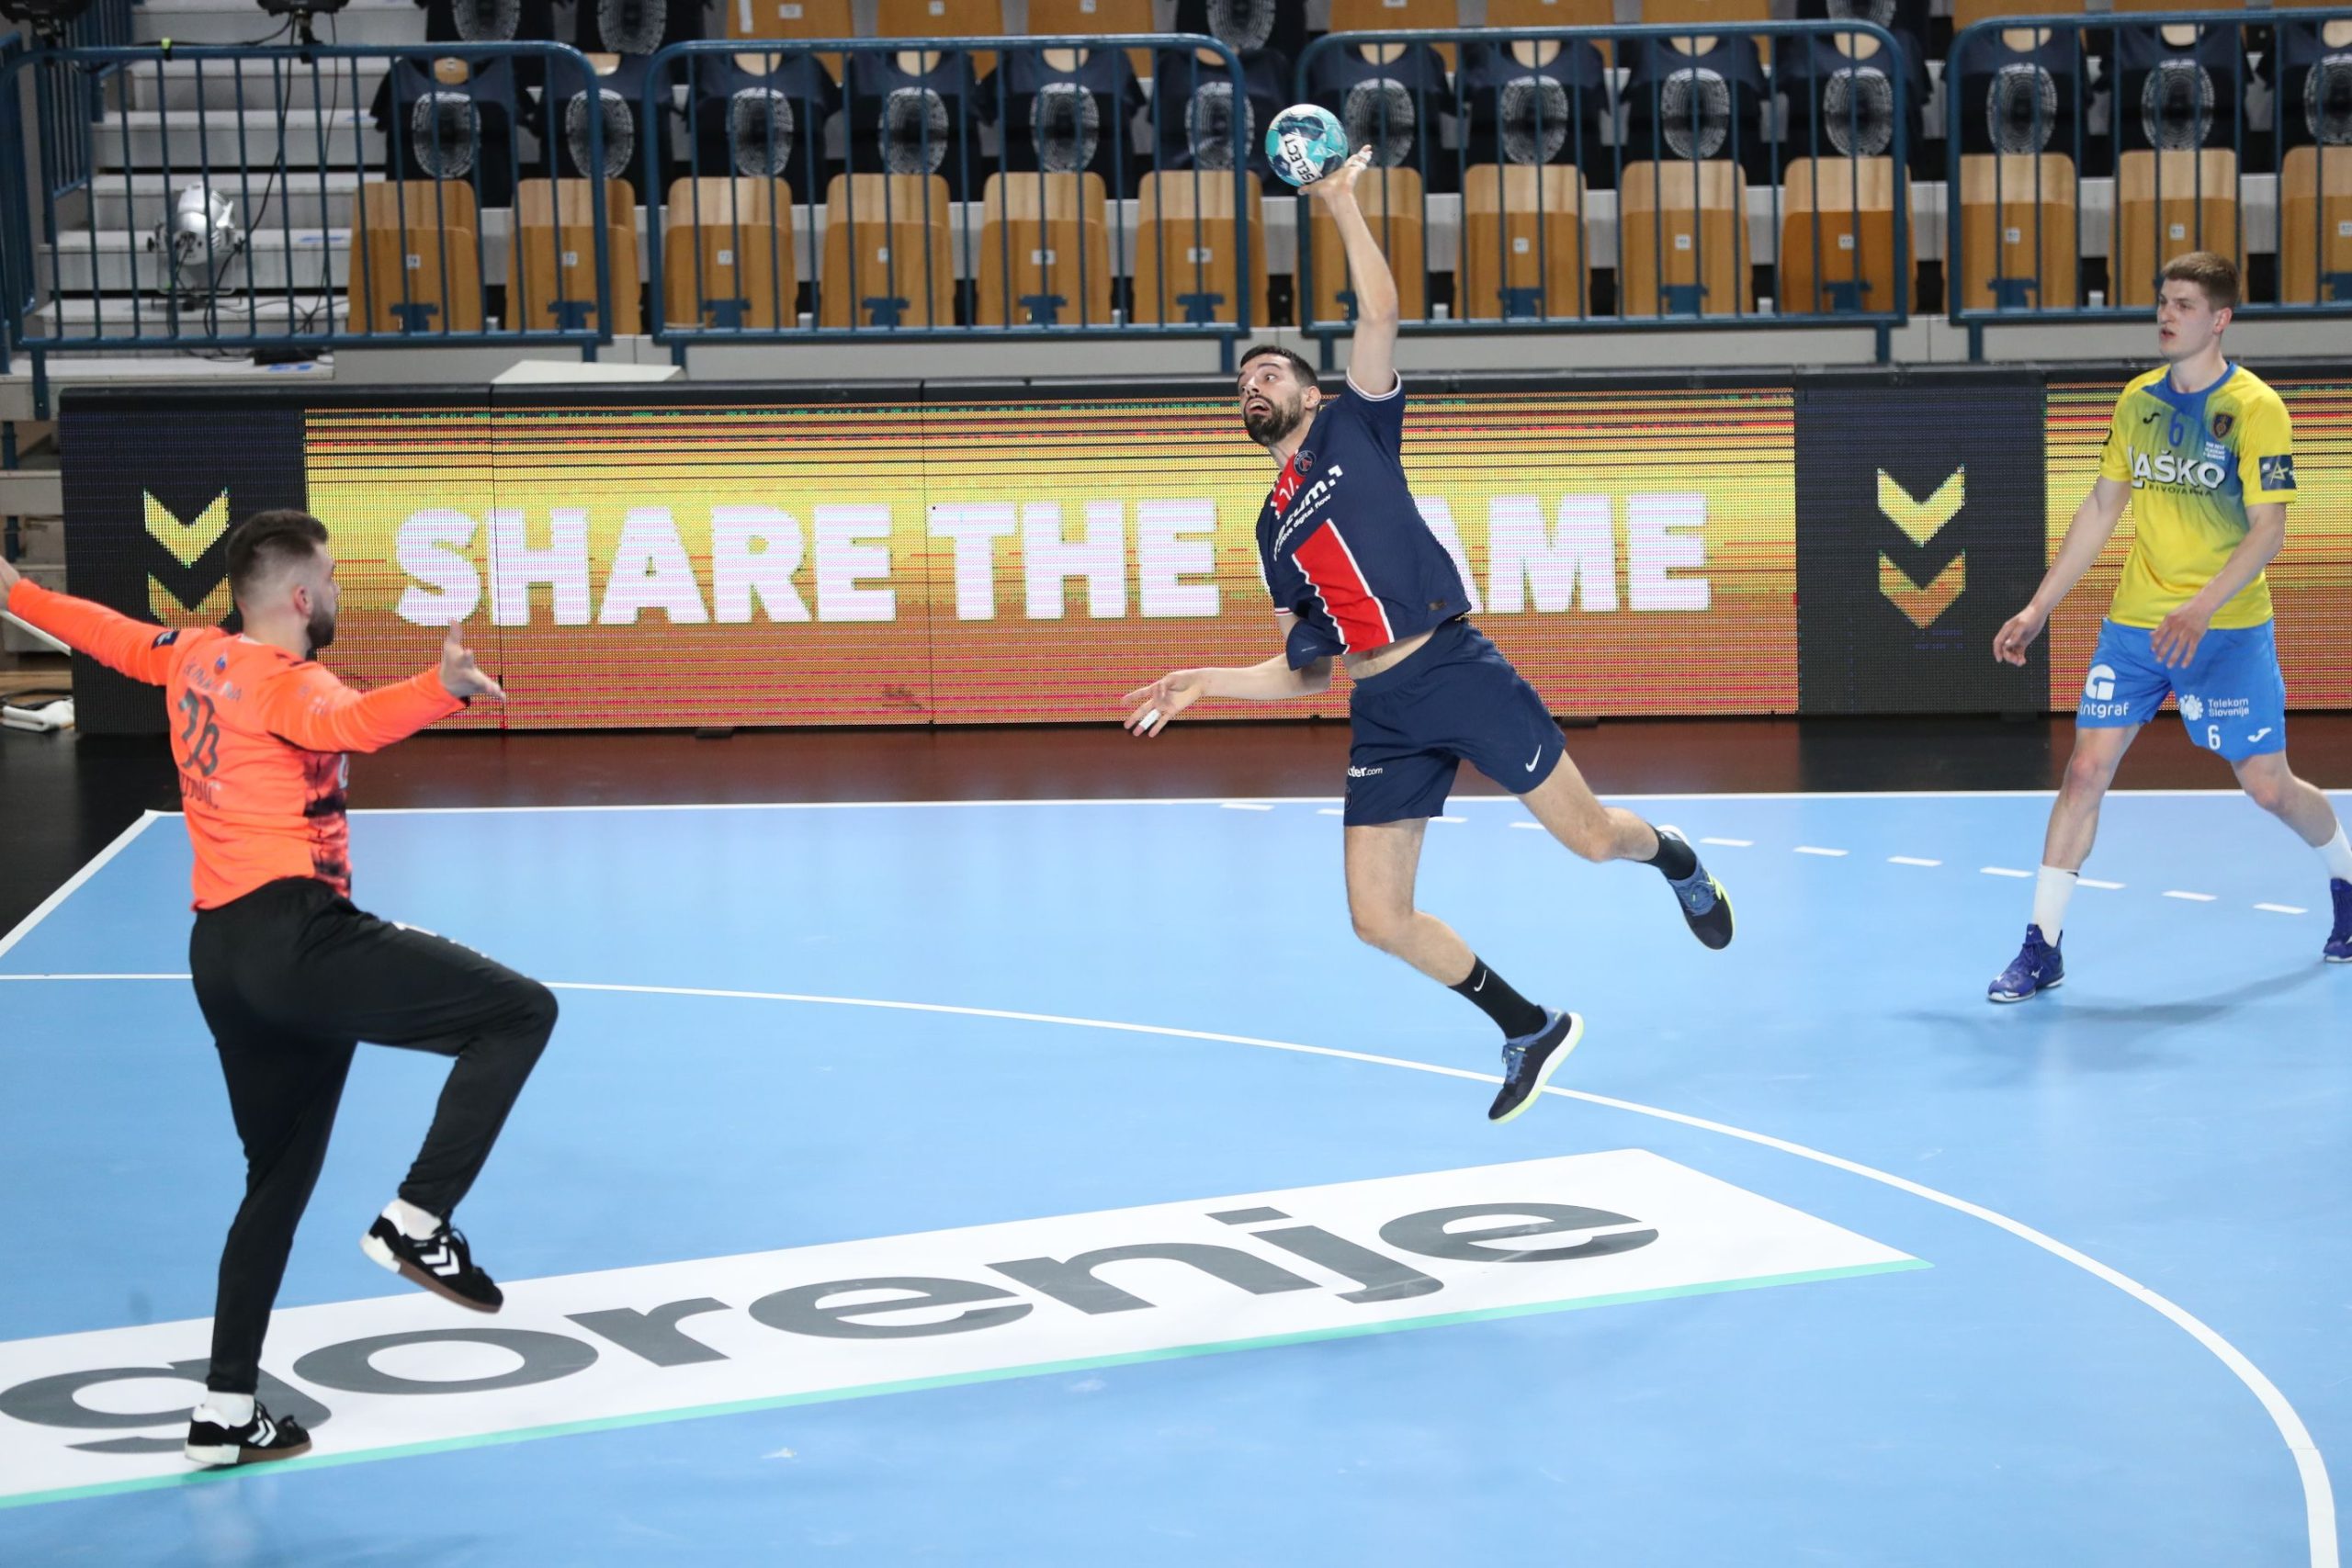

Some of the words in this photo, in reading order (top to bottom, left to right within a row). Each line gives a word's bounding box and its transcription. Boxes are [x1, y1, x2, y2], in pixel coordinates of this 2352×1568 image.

[1284, 137, 1316, 182] SELECT
[2168, 413, 2184, 447] 6
[395, 504, 897, 627] SHARE
[931, 499, 1221, 621] THE
[1415, 491, 1711, 615] ME
[2208, 697, 2249, 708] Telekom
[2208, 706, 2250, 717] Slovenije
[2207, 724, 2222, 750] 6
[0, 1201, 1660, 1455] gorenje
